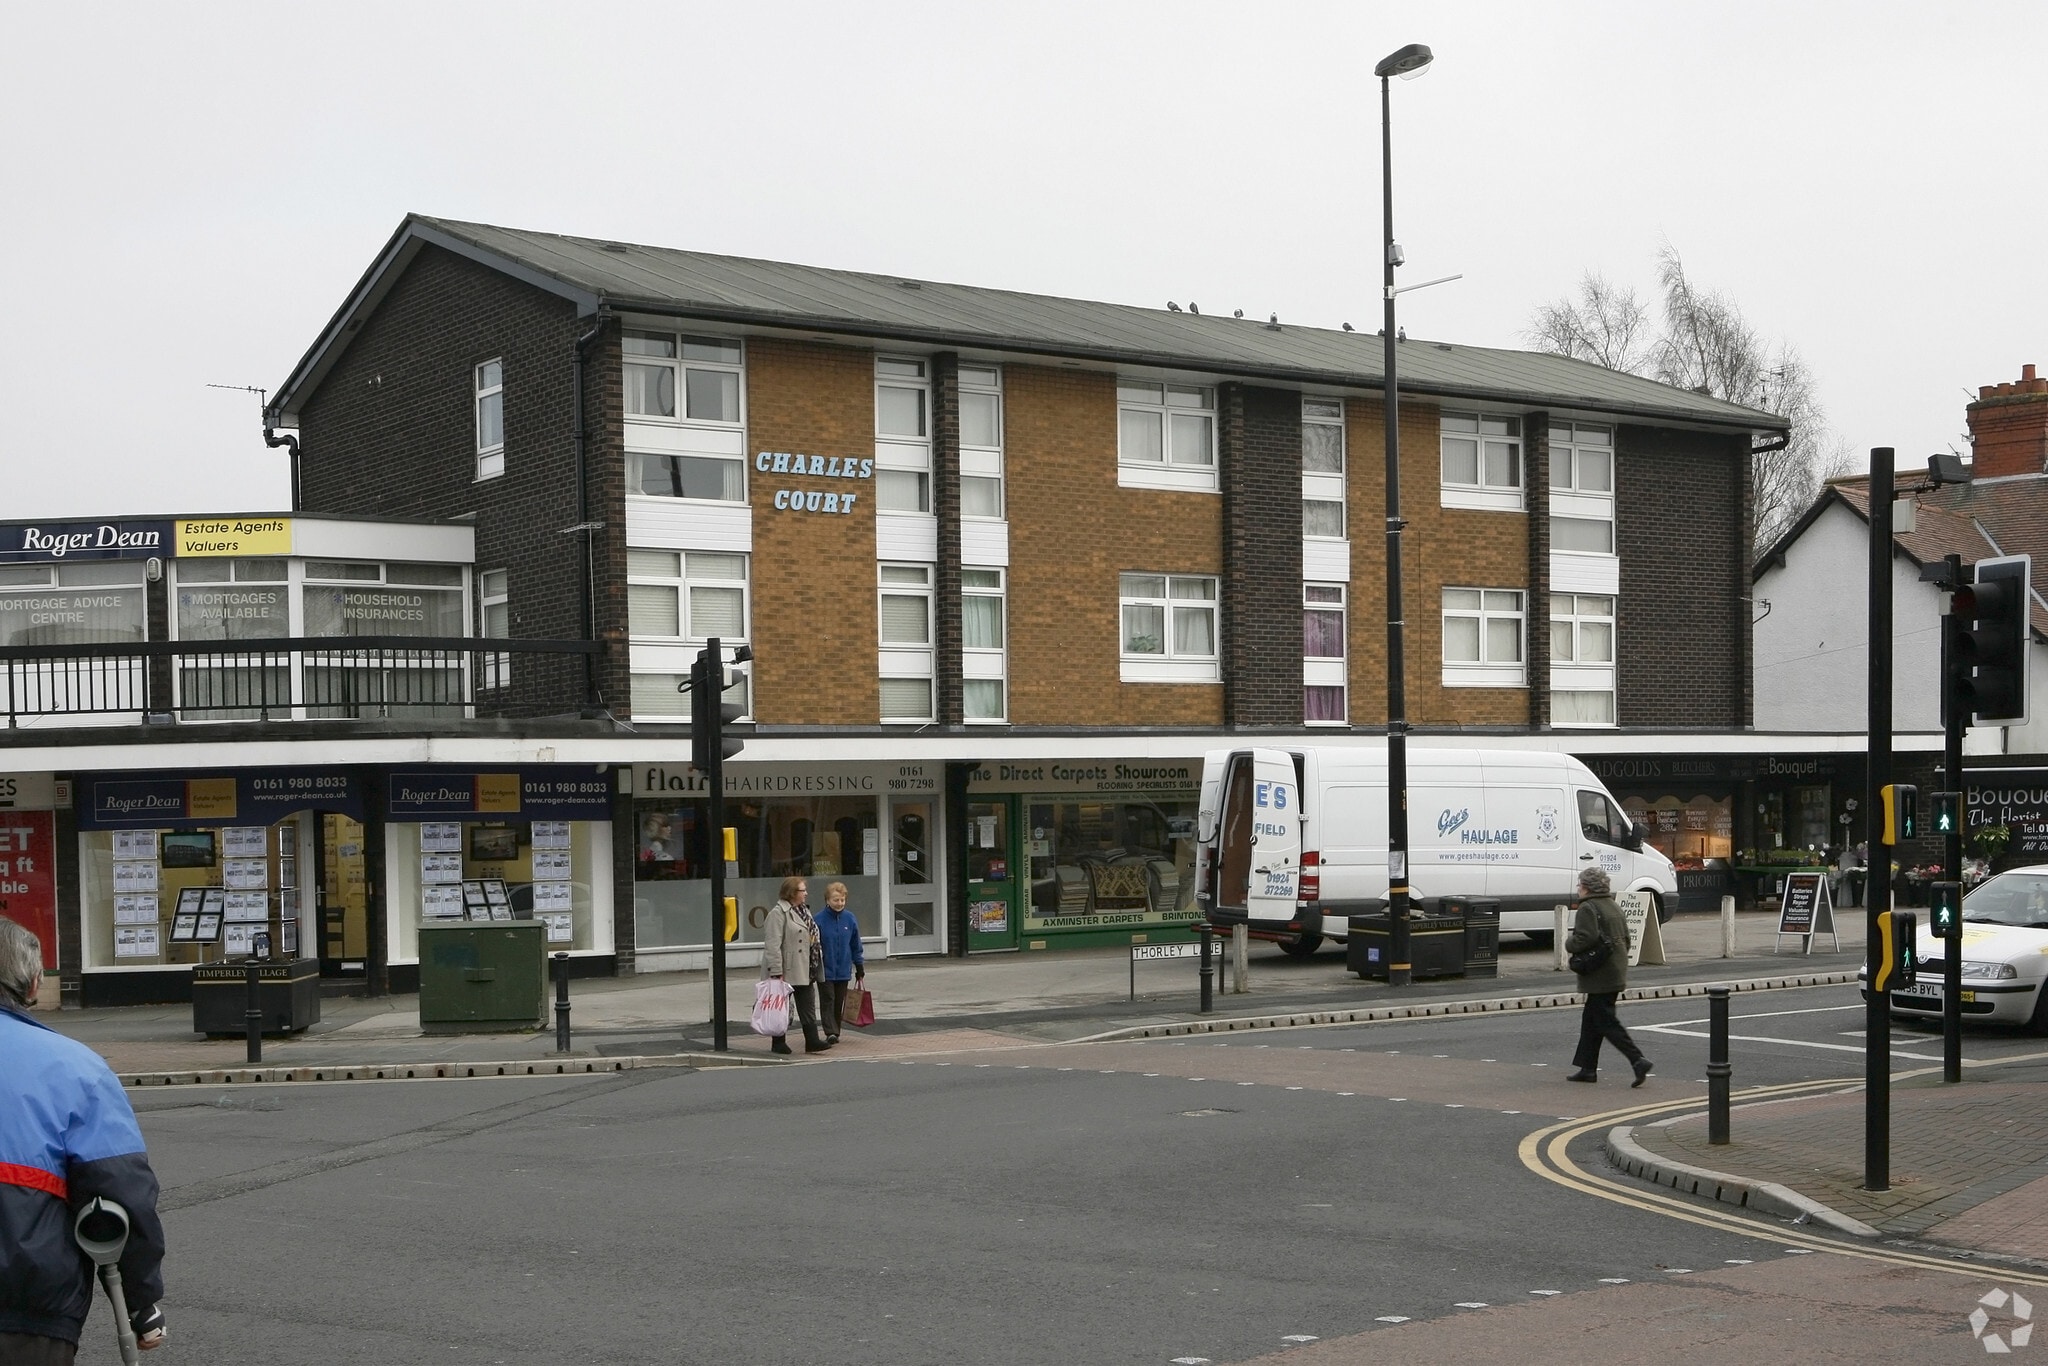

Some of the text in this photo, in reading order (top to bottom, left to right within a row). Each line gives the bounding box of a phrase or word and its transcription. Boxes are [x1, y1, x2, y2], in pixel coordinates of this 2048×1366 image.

[756, 452, 875, 479] CHARLES
[774, 490, 857, 514] COURT
[186, 520, 284, 534] Estate Agents
[23, 525, 160, 556] Roger Dean
[186, 540, 239, 552] Valuers
[73, 596, 123, 608] ADVICE
[192, 592, 277, 604] MORTGAGES
[345, 593, 422, 607] HOUSEHOLD
[31, 611, 86, 624] CENTRE
[200, 607, 270, 619] AVAILABLE
[344, 608, 424, 621] INSURANCES
[900, 766, 923, 777] 0161
[1672, 761, 1716, 773] BUTCHERS
[1769, 757, 1818, 779] Bouquet
[646, 768, 874, 792] flair HAIRDRESSING
[968, 764, 1189, 784] he Direct Carpets Showroom
[254, 777, 347, 789] 0161 980 8033
[525, 782, 608, 793] 0161 980 8033
[888, 779, 934, 789] 980 7298
[1097, 781, 1133, 790] FLOORING
[1137, 780, 1177, 789] SPECIALISTS
[253, 791, 348, 802] www.roger-dean.co.uk
[401, 787, 470, 804] Roger Dean
[525, 797, 607, 805] www.roger-dean.co.uk
[106, 795, 181, 811] Roger Dean
[1437, 808, 1470, 837] Gee's
[1967, 806, 2042, 827] The florist
[1255, 823, 1286, 837] FIELD
[1461, 829, 1518, 845] HAULAGE
[1439, 851, 1520, 862] www.geeshaulage.co.uk
[1600, 854, 1617, 862] 01924
[16, 857, 34, 873] ft
[1267, 872, 1290, 883] 01924
[1683, 874, 1727, 888] PRIORIT
[1264, 884, 1293, 896] 372269
[1621, 900, 1641, 908] Direct
[1042, 910, 1208, 927] AXMINSTER CARPETS BRINTONS
[1624, 909, 1645, 918] rpets
[1410, 921, 1438, 930] IMPERLEY
[1133, 943, 1220, 959] THORLEY LE
[196, 968, 289, 979] TIMPERLEY LLAGE
[1919, 984, 1938, 996] BYL
